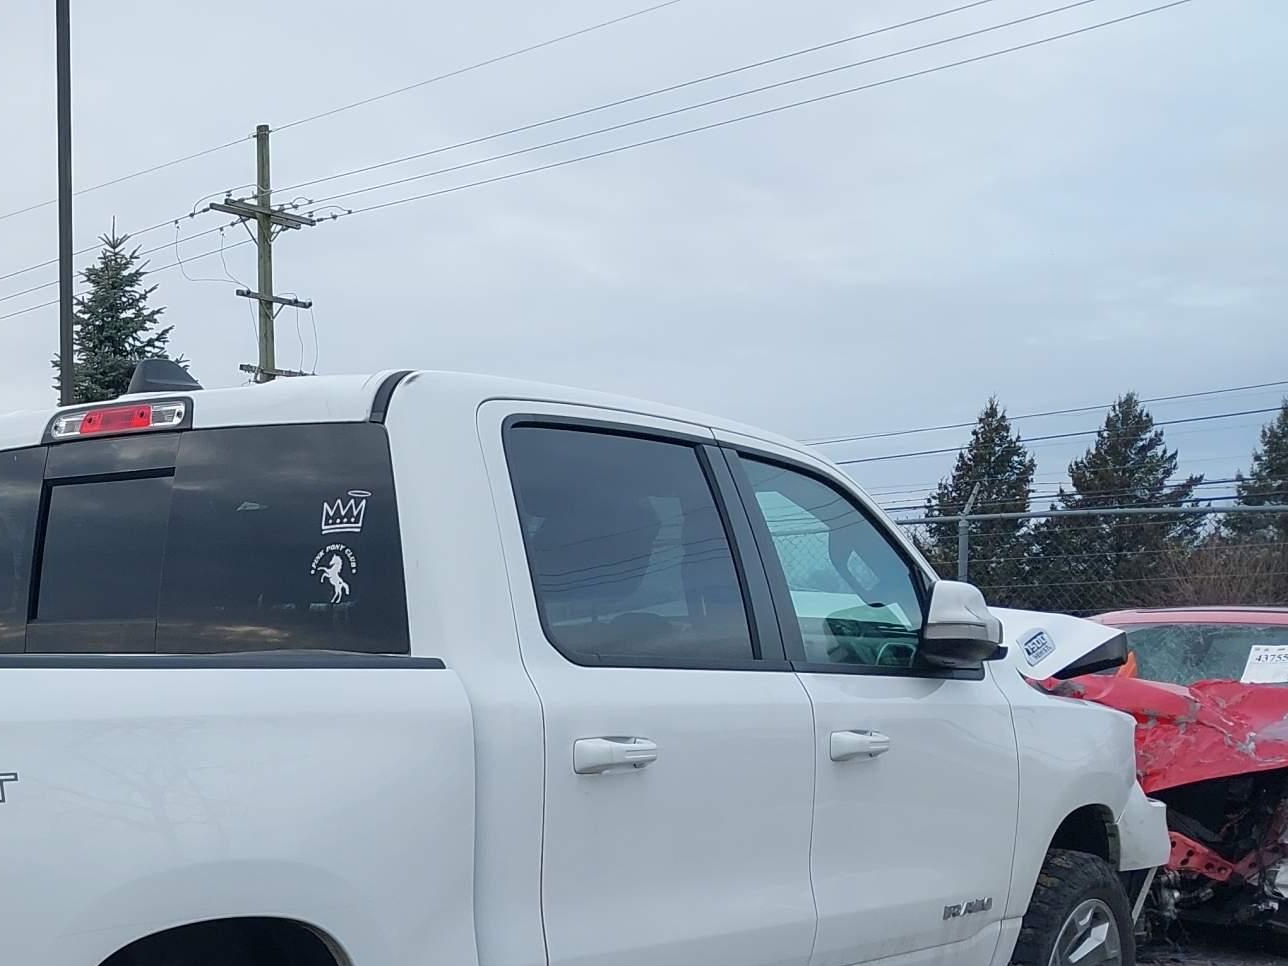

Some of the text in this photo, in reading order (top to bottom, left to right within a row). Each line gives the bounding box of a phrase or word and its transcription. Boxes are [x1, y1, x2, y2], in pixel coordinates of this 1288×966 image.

[312, 544, 357, 569] PINK PONY CLUB
[942, 897, 993, 921] RAM
